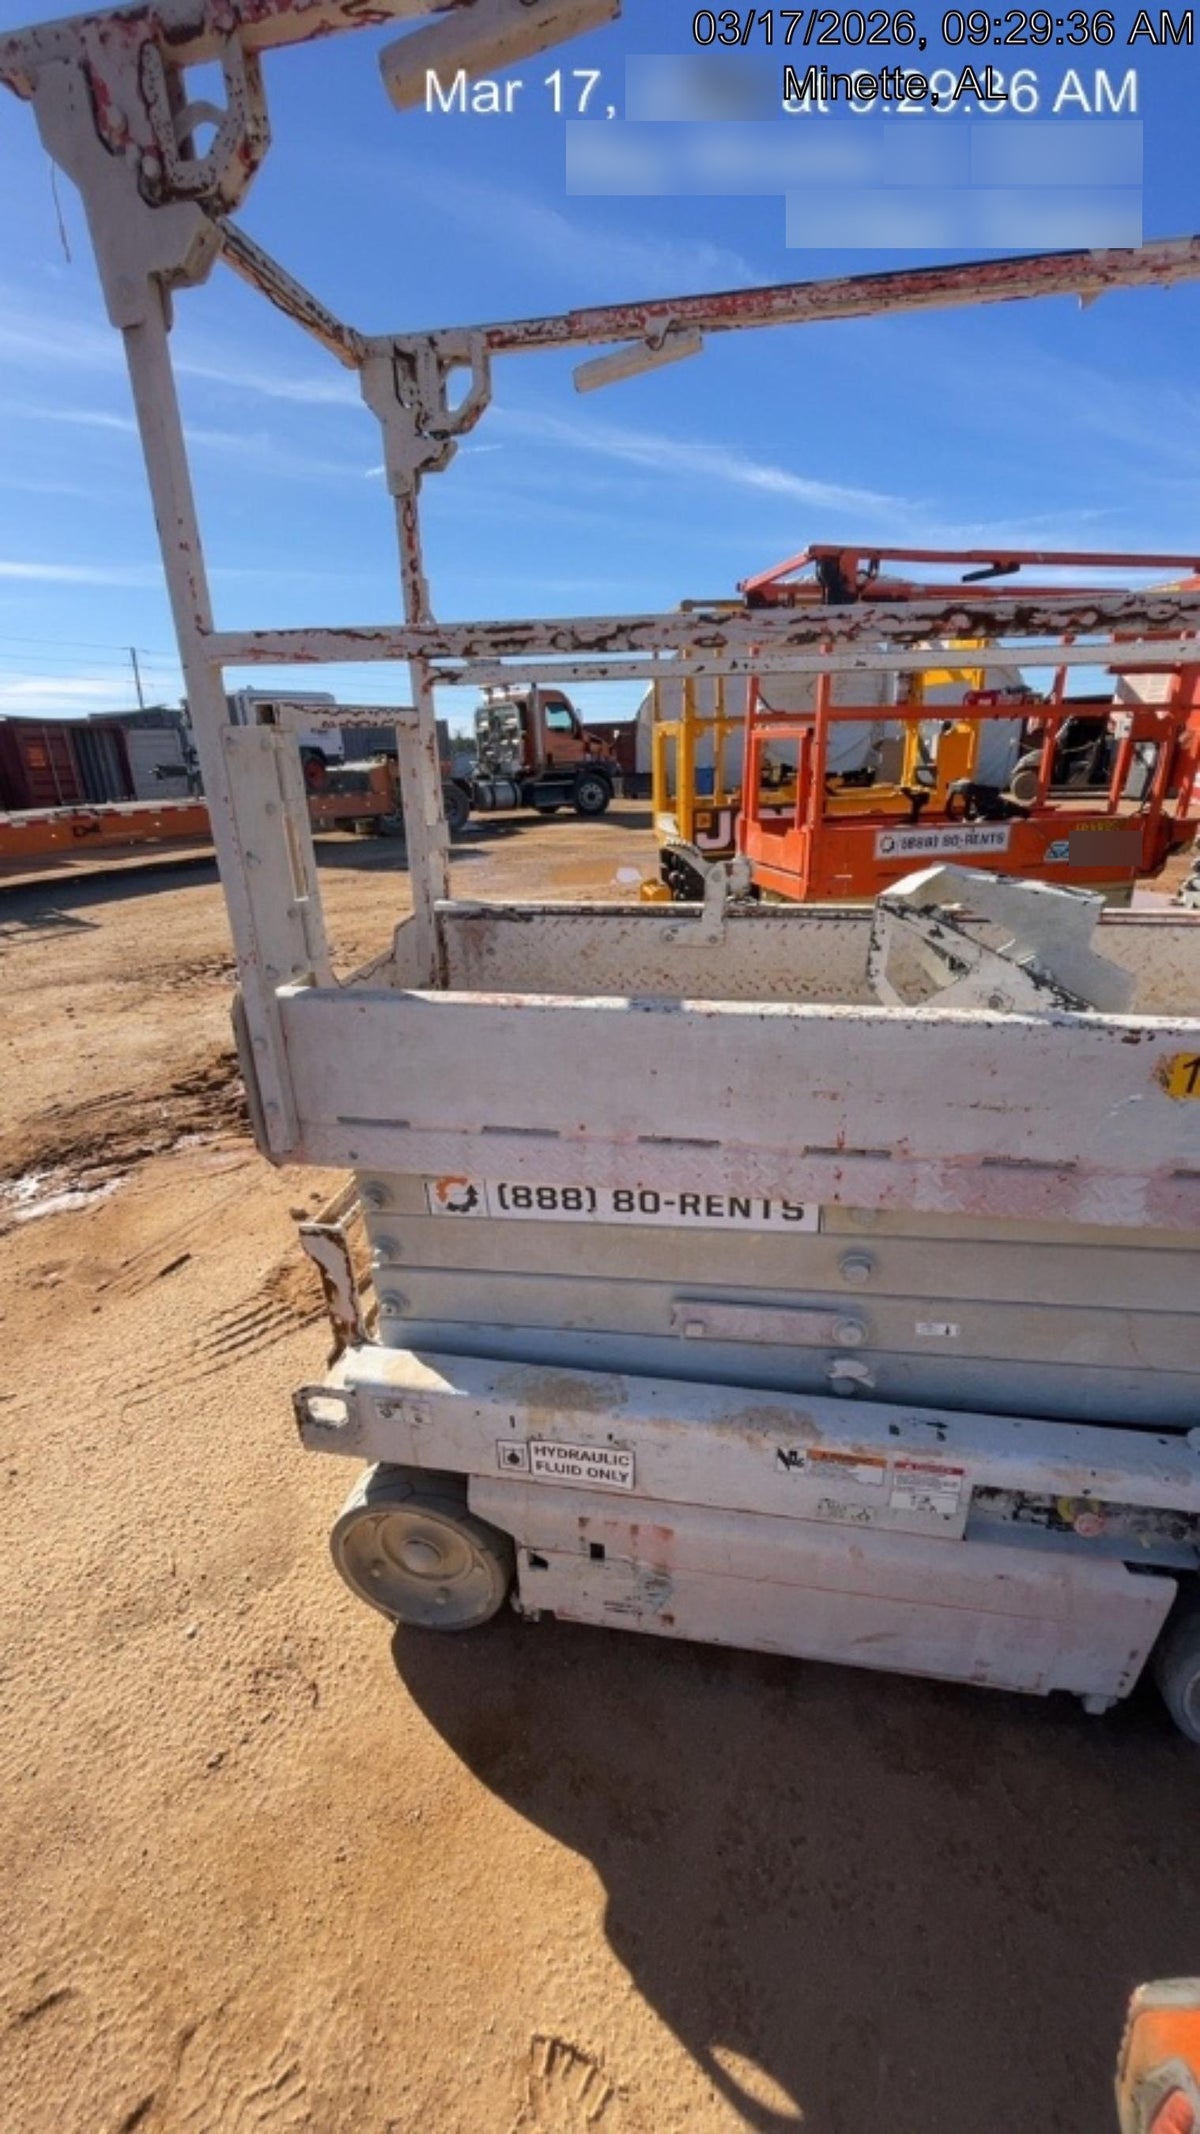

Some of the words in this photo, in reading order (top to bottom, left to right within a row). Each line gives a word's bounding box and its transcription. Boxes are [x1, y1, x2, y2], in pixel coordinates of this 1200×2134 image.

[497, 1183, 596, 1212] (888)
[612, 1189, 804, 1221] 80-RENTS
[534, 1446, 630, 1466] HYDRAULIC
[536, 1461, 582, 1476] FLUID
[587, 1467, 630, 1483] ONLY
